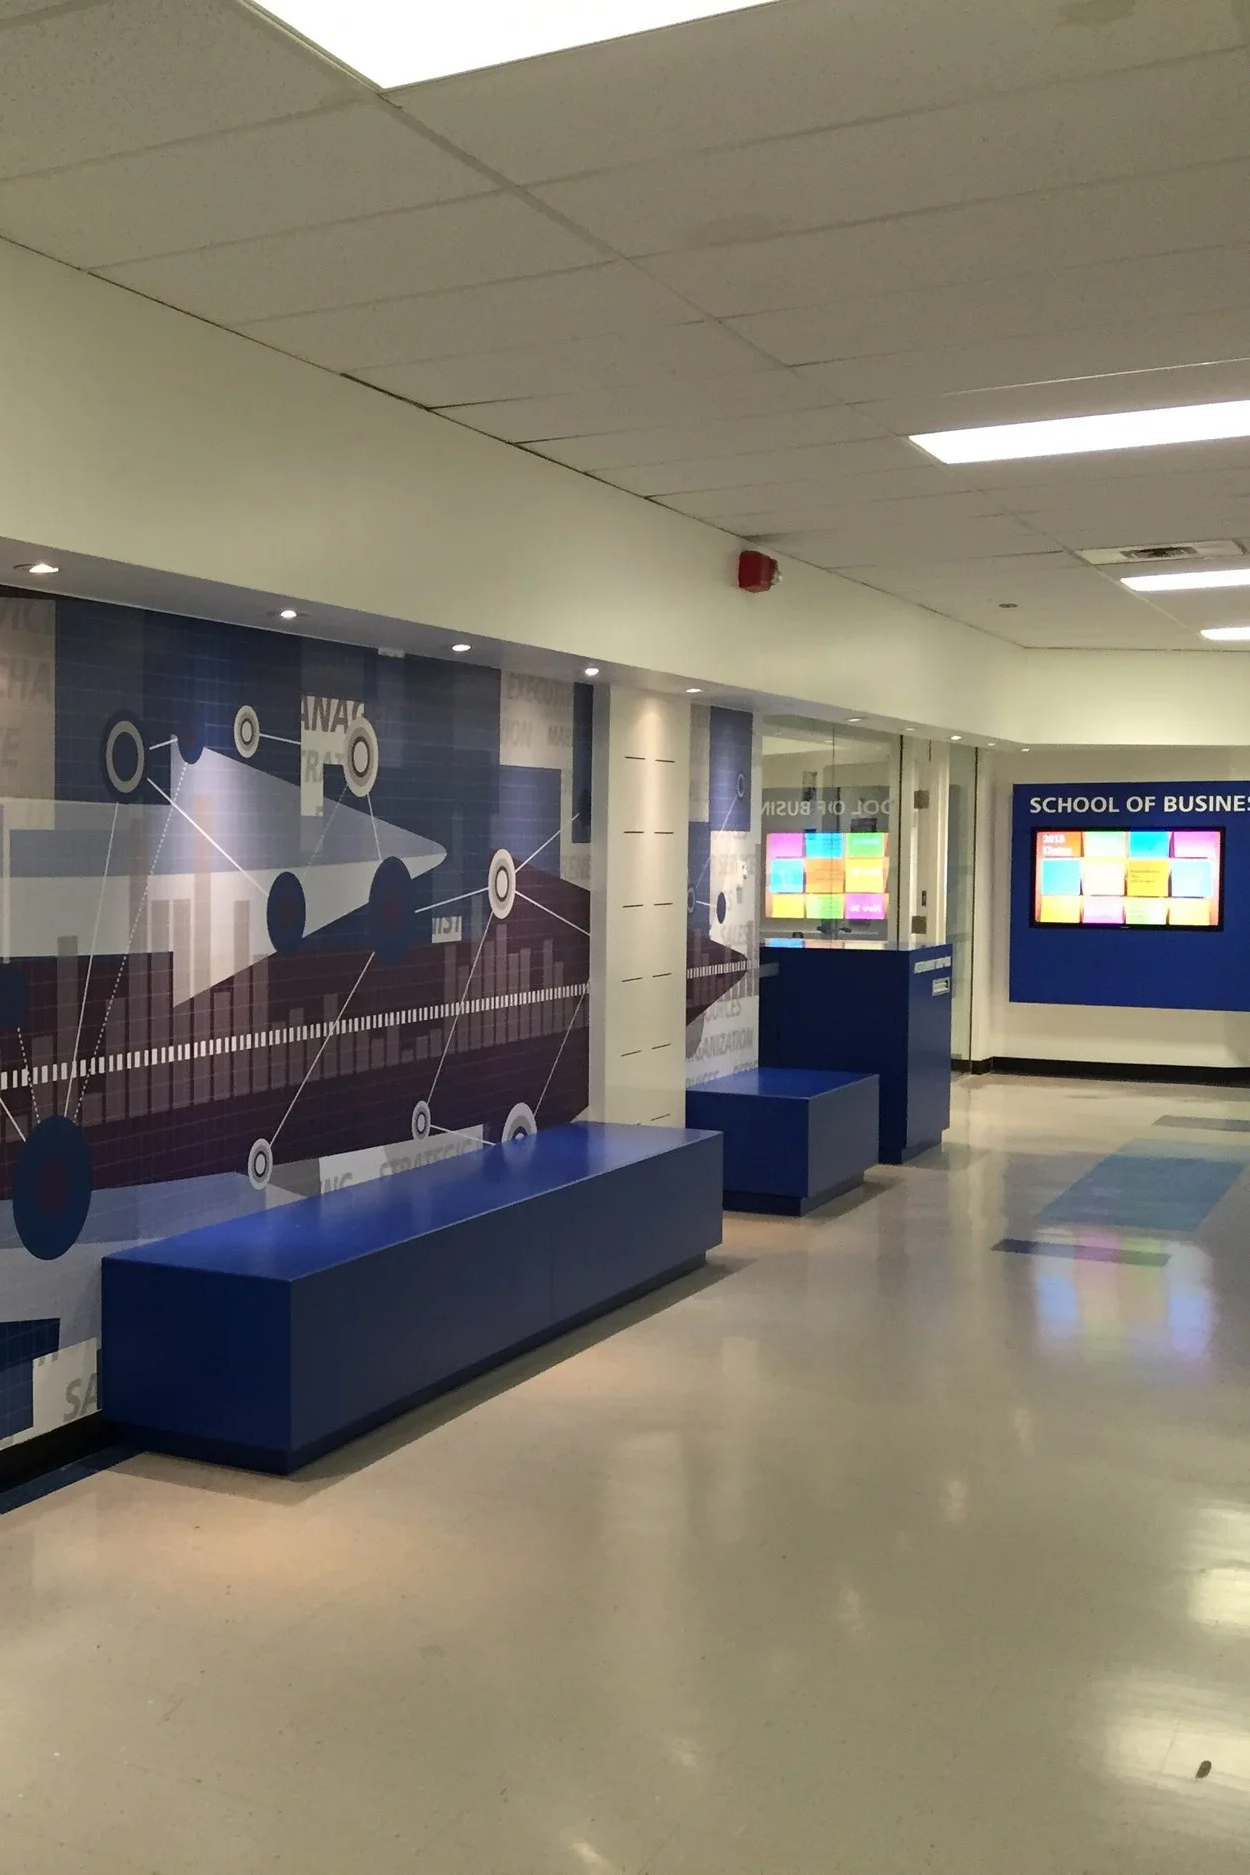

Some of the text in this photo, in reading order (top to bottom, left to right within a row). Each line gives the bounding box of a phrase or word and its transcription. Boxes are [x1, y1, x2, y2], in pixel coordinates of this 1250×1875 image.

[1030, 795, 1250, 813] SCHOOL OF BUSINE
